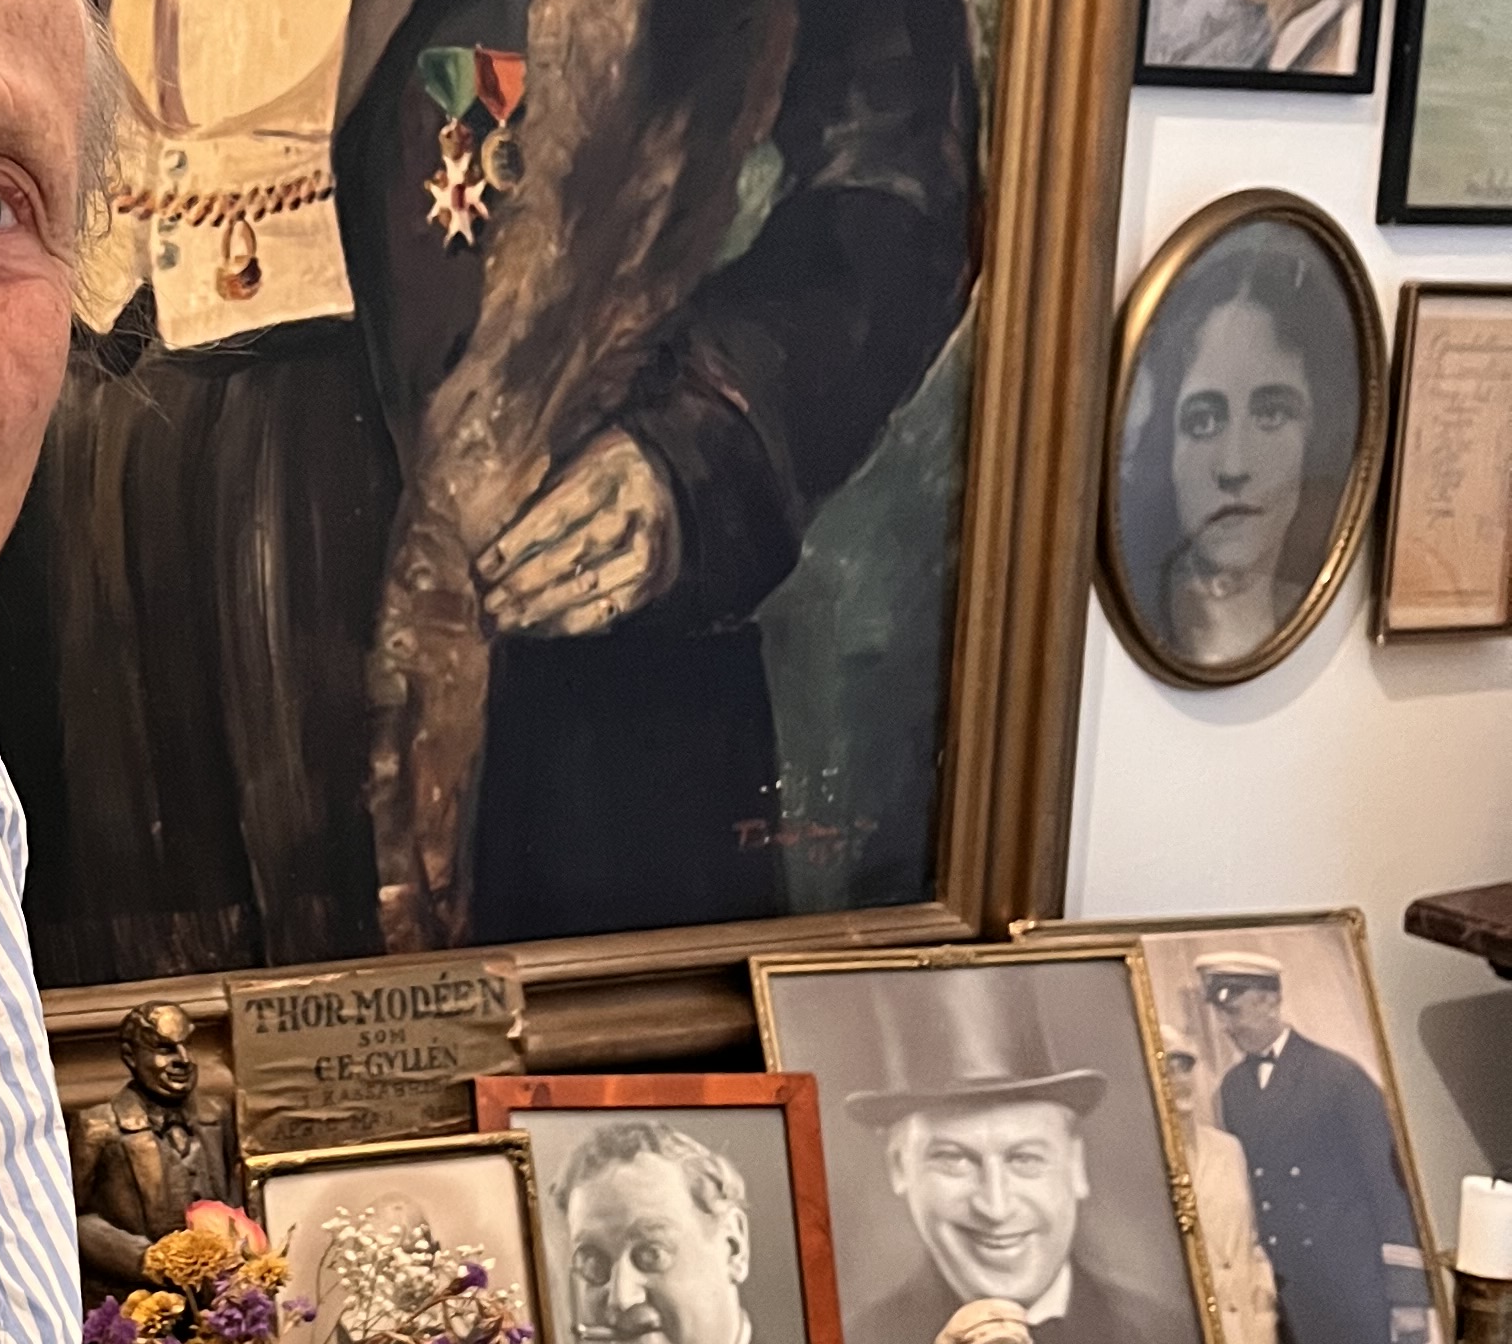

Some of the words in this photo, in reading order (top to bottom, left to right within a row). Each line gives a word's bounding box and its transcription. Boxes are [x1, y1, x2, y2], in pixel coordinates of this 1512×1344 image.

[245, 991, 349, 1034] THOR
[350, 971, 508, 1026] MODÉEN
[358, 1028, 407, 1048] SOM
[364, 1037, 459, 1078] GYLLÉN
